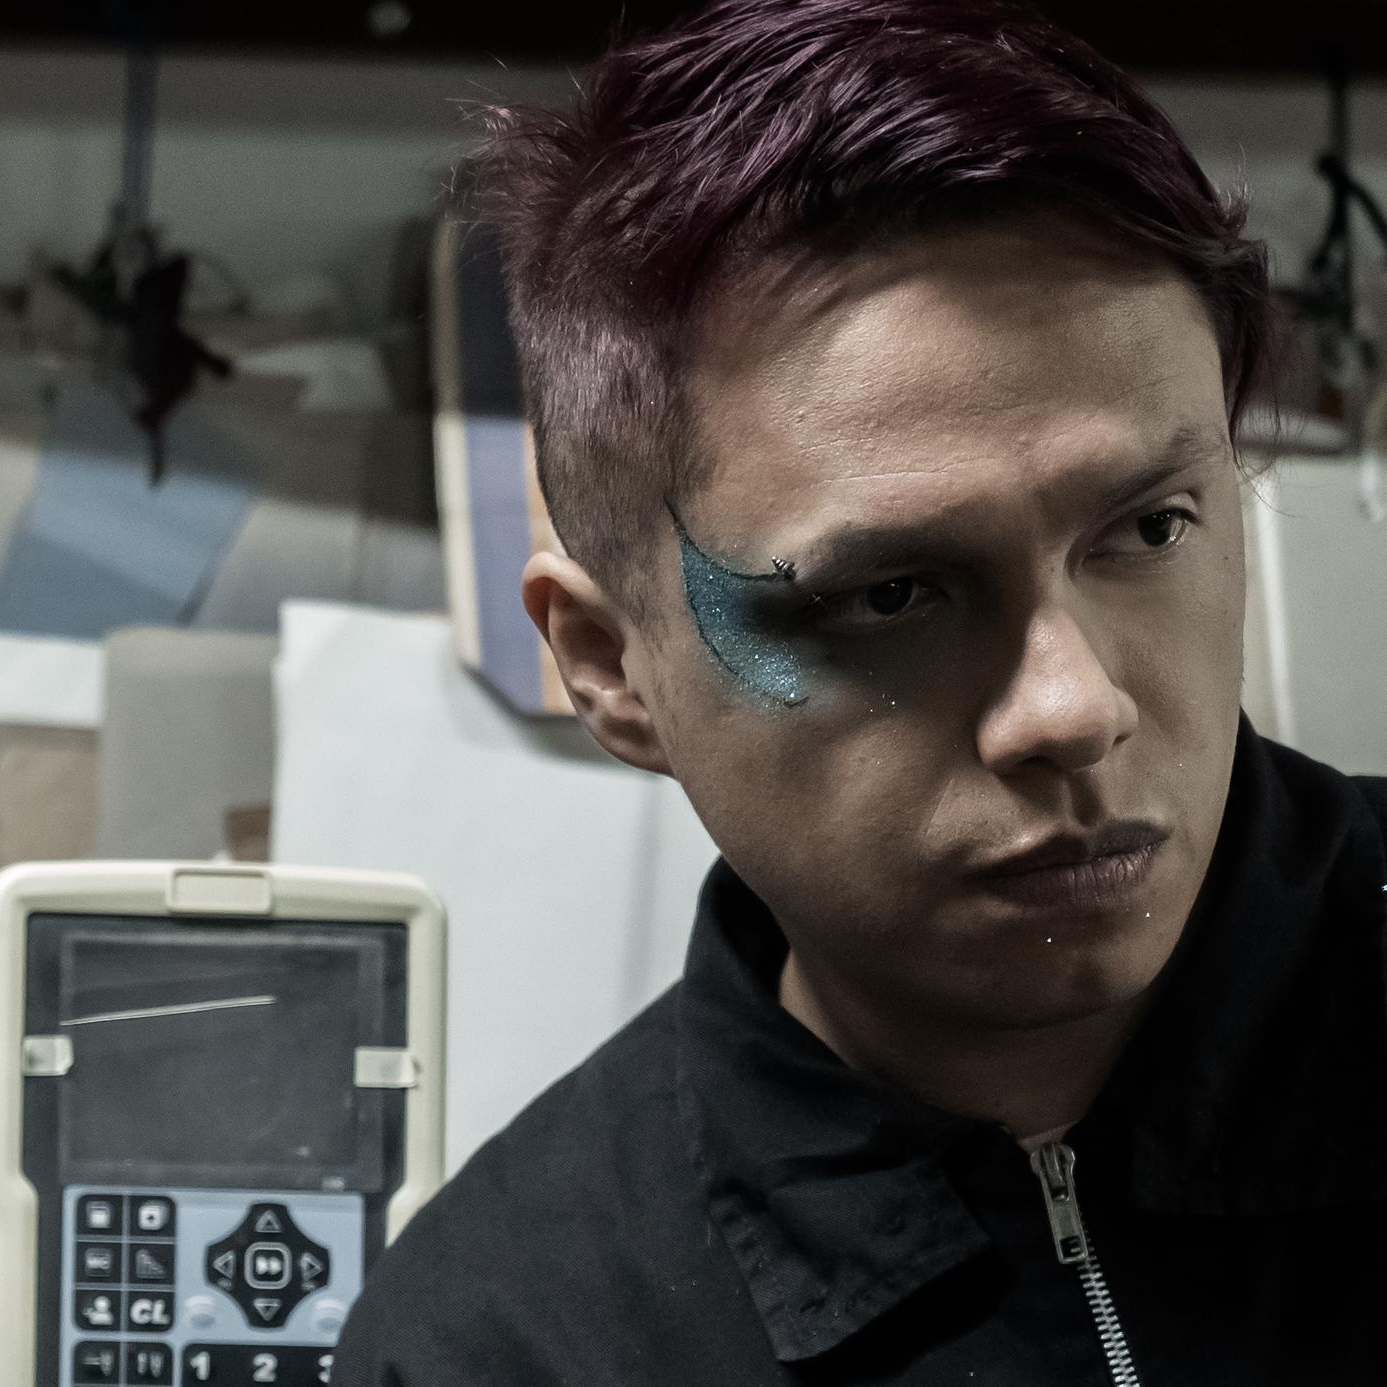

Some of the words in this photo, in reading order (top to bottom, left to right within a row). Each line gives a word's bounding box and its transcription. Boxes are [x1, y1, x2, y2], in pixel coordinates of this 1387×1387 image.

[129, 1297, 170, 1325] CL
[190, 1351, 211, 1381] 1
[252, 1352, 278, 1382] 2
